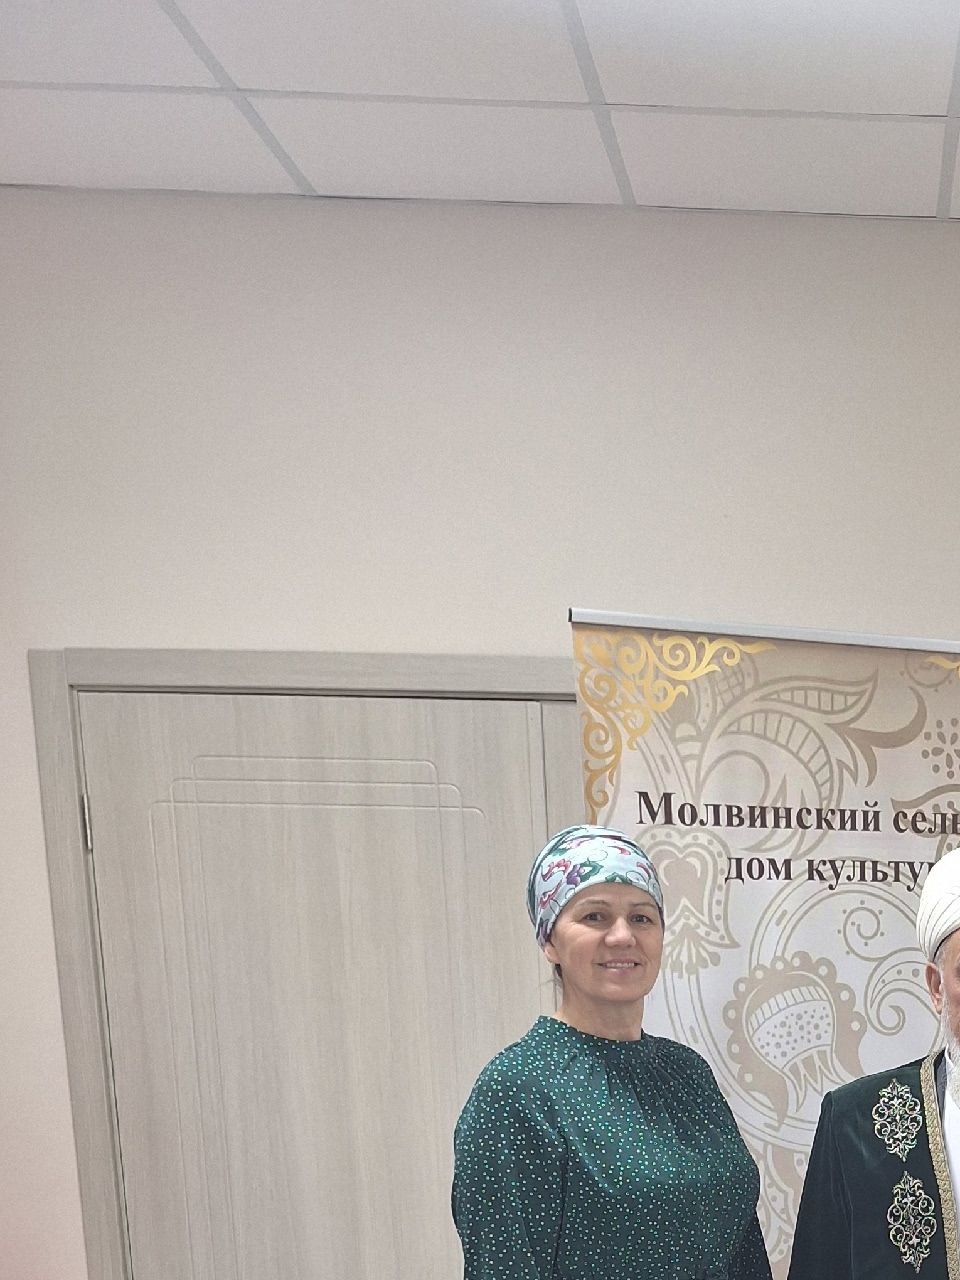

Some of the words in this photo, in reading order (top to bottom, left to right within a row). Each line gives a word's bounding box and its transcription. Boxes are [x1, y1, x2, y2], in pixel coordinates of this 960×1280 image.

[635, 791, 882, 833] Молвинский
[725, 857, 793, 885] дом
[806, 858, 936, 892] культу
